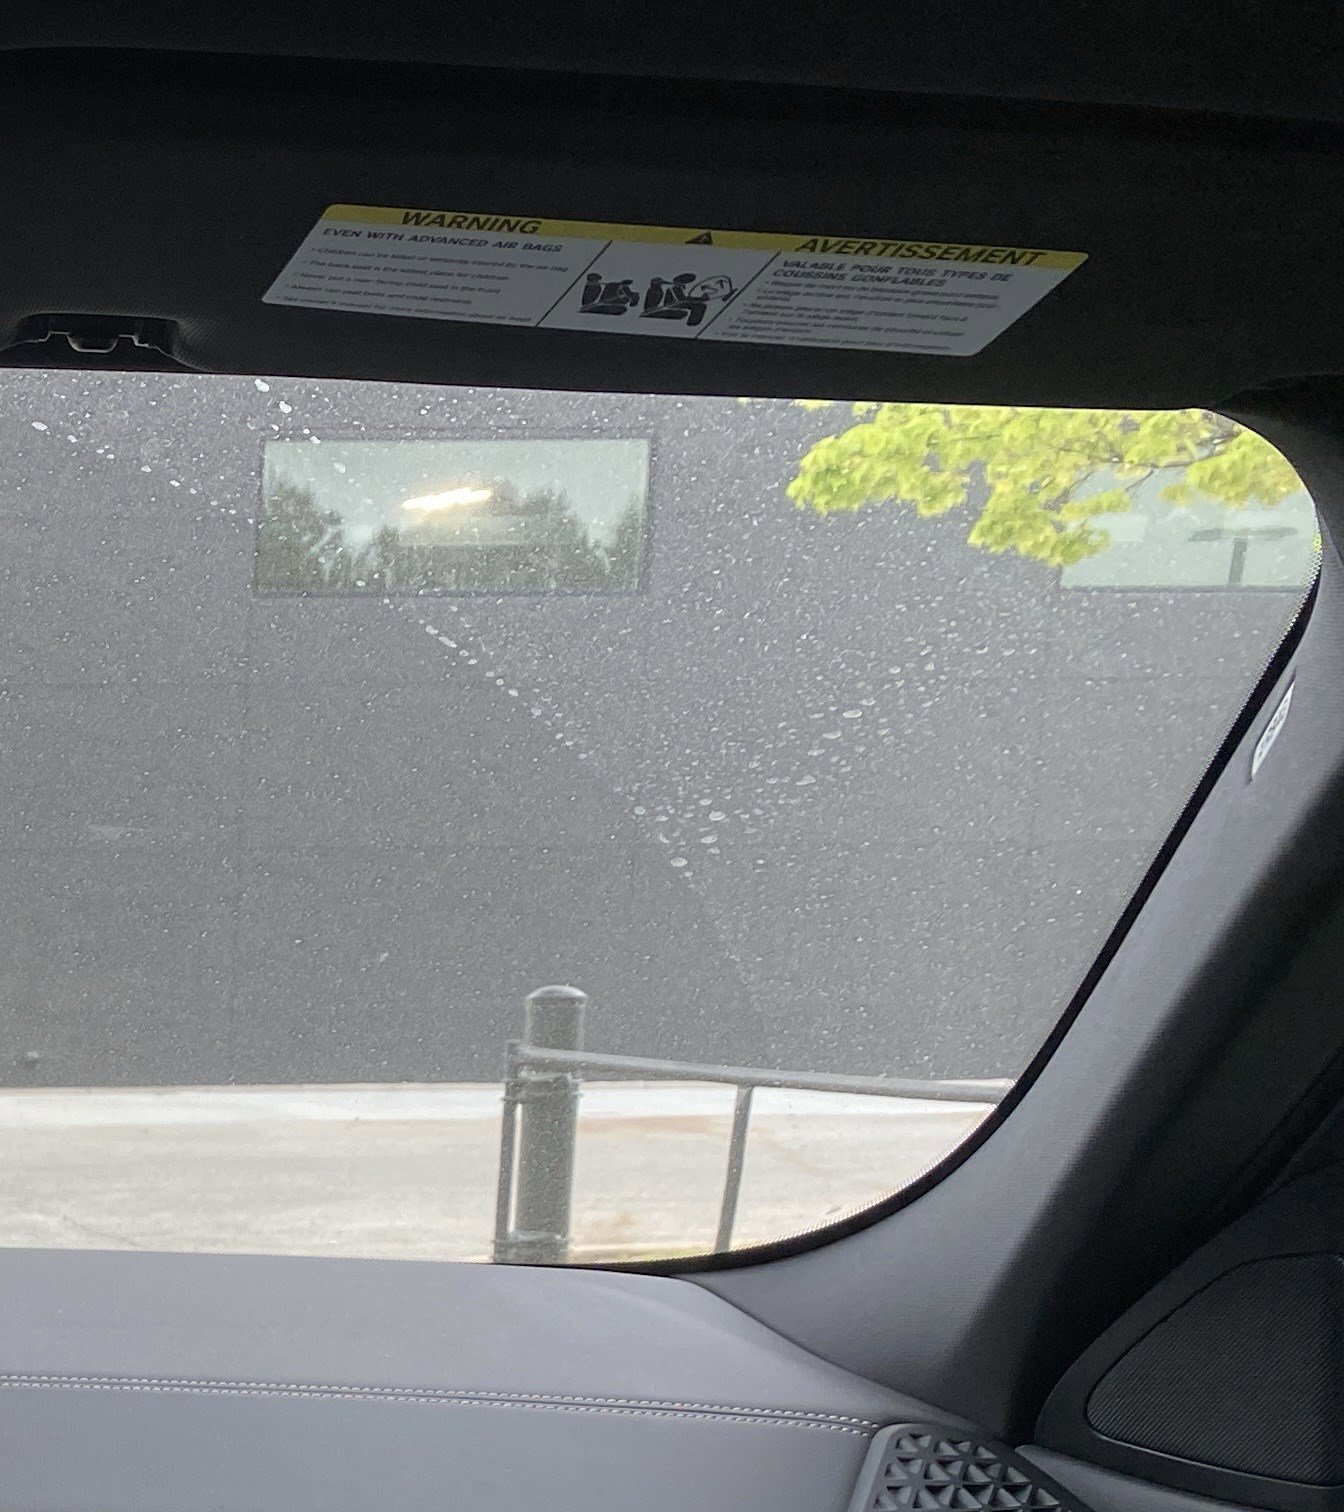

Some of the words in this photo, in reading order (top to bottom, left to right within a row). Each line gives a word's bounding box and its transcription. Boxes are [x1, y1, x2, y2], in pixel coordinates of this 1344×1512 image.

[401, 211, 542, 234] WARNING
[322, 228, 362, 238] EVEN
[367, 231, 403, 241] WITH
[408, 234, 488, 247] ADVANCED
[492, 241, 519, 249] AIR
[522, 243, 563, 253] BAGS
[795, 238, 1049, 266] AVERTISSEMENT
[773, 270, 847, 281] COUSSINS
[783, 259, 846, 271] VALABLE
[850, 263, 893, 273] POUR
[897, 266, 935, 276] TOUS
[942, 269, 988, 280] TYPES
[990, 273, 1012, 282] DE
